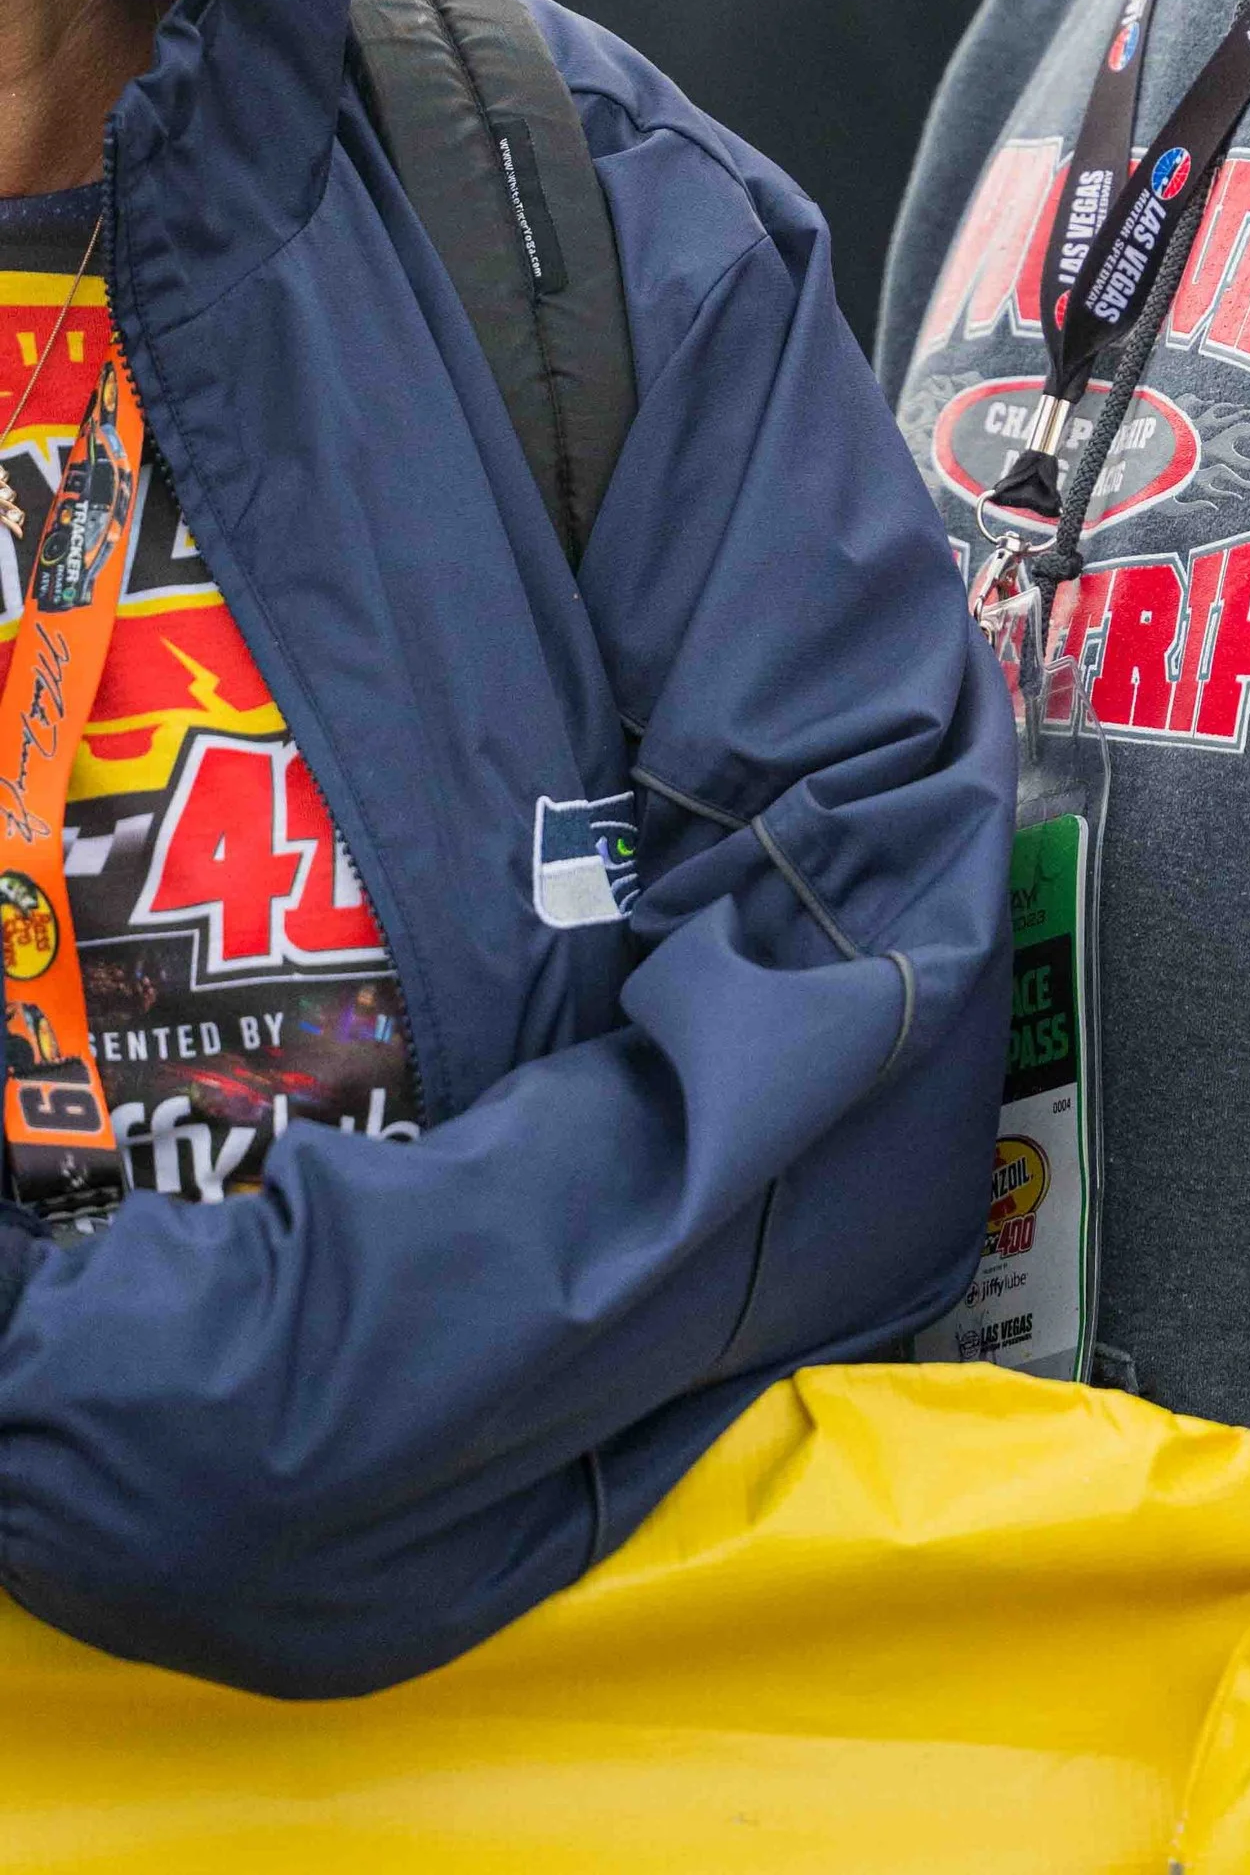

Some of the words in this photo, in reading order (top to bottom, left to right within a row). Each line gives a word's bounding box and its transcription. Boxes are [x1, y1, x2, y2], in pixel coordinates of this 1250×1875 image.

[1065, 169, 1105, 239] VEGAS
[1119, 188, 1151, 239] MOTOR
[1132, 196, 1167, 251] LAS
[1057, 242, 1091, 285] LAS
[1084, 237, 1125, 310] SPEEDWAY
[1094, 244, 1149, 325] VEGAS
[65, 500, 90, 584] TRACKER
[239, 1011, 284, 1050] BY
[1052, 1097, 1072, 1115] 0004
[996, 1212, 1037, 1260] 400
[980, 1324, 999, 1345] LAS
[1000, 1312, 1034, 1340] VEGAS
